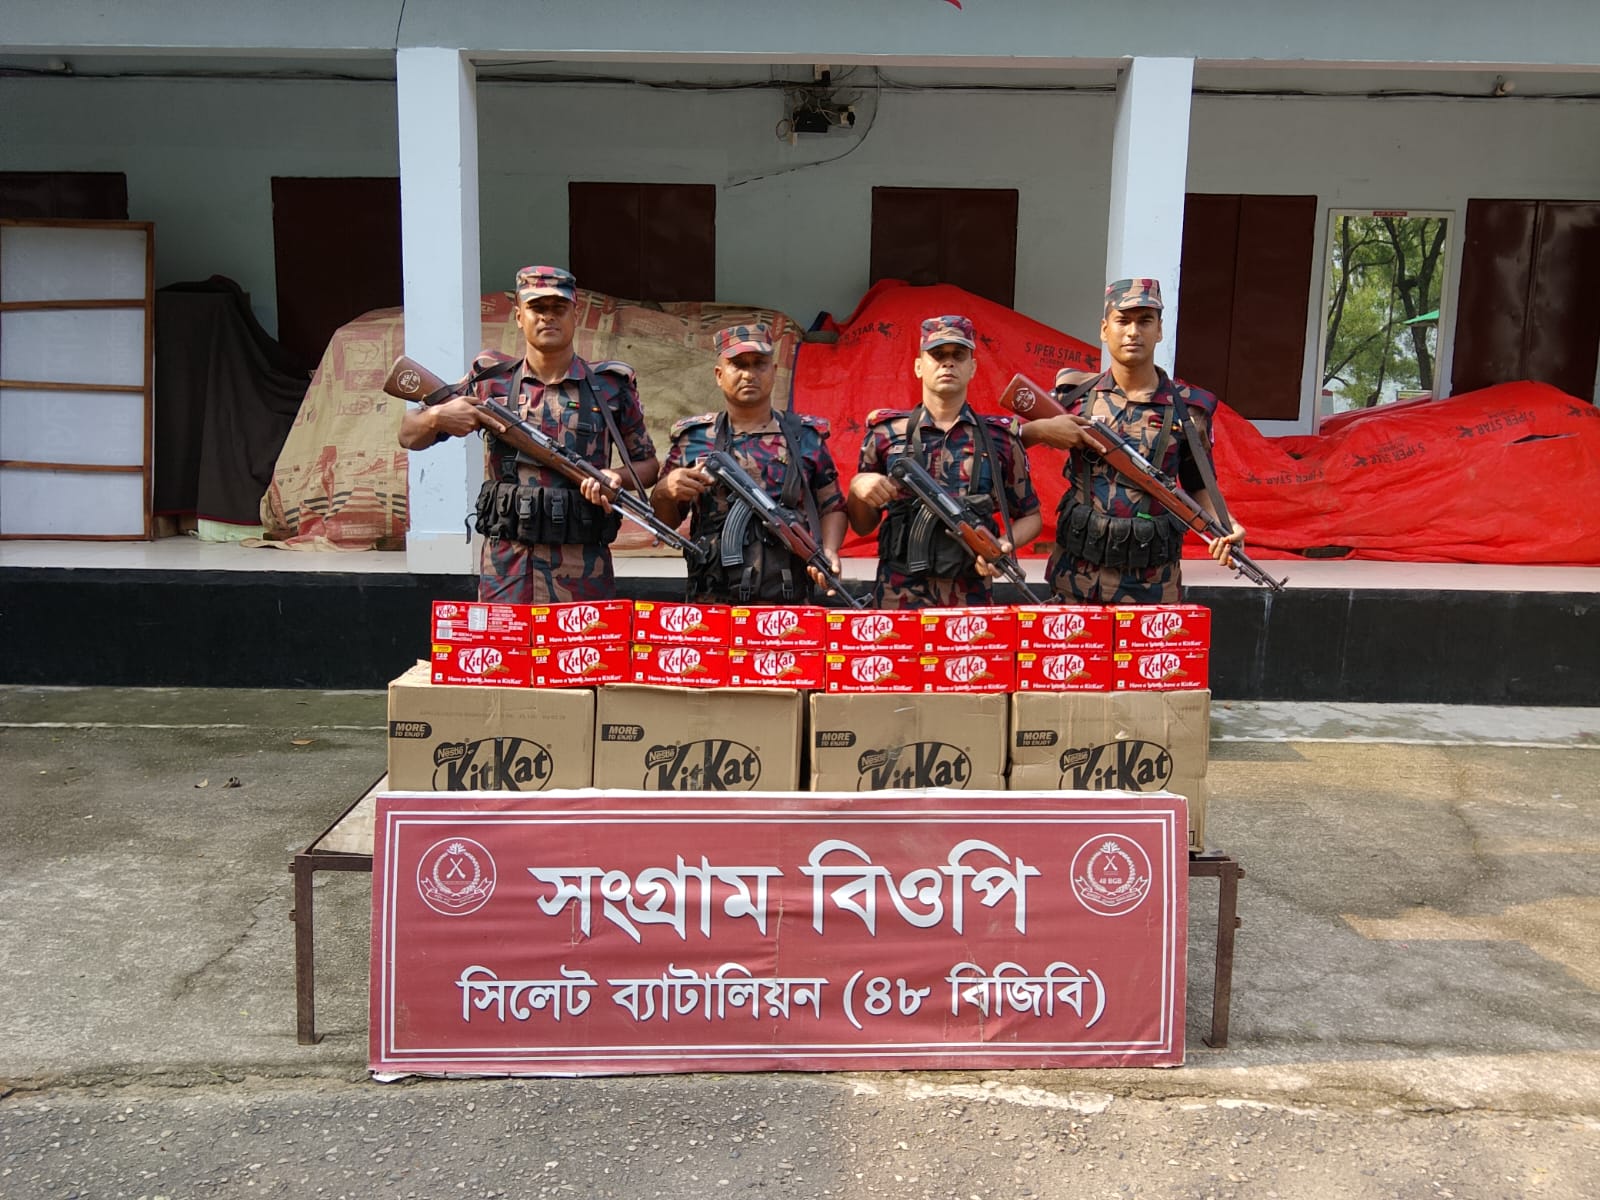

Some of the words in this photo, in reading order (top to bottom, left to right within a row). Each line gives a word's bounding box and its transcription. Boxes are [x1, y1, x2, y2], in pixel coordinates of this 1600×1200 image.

[1058, 347, 1082, 363] STAR
[1475, 419, 1504, 435] STAR
[563, 607, 597, 632] KitKat
[665, 607, 700, 631] KitKat
[761, 610, 796, 635] KitKat
[856, 615, 891, 641] KitKat
[950, 616, 985, 641] KitKat
[1048, 613, 1082, 639] KitKat
[1146, 613, 1180, 638] KitKat
[464, 648, 500, 673] KitKat
[563, 647, 597, 673] KitKat
[663, 647, 698, 672] KitKat
[759, 650, 793, 675] KitKat
[857, 656, 891, 681] KitKat
[950, 656, 985, 681] KitKat
[1048, 654, 1082, 679] KitKat
[1144, 653, 1178, 678] KitKat
[395, 723, 427, 732] MORE
[608, 726, 640, 735] MORE
[822, 732, 852, 741] MORE
[1023, 731, 1054, 740] MORE
[447, 738, 548, 790] KitKat
[659, 741, 756, 790] KitKat
[871, 743, 966, 789] KitKat
[1073, 741, 1169, 791] KitKat
[527, 854, 784, 944] সংগ্রাম
[799, 839, 1042, 936] বিওপি
[454, 964, 599, 1023] সিলেট
[607, 962, 829, 1023] ব্যাটালিয়ন
[843, 969, 931, 1030] (৪৮
[944, 961, 1107, 1030] বিজিবি)
